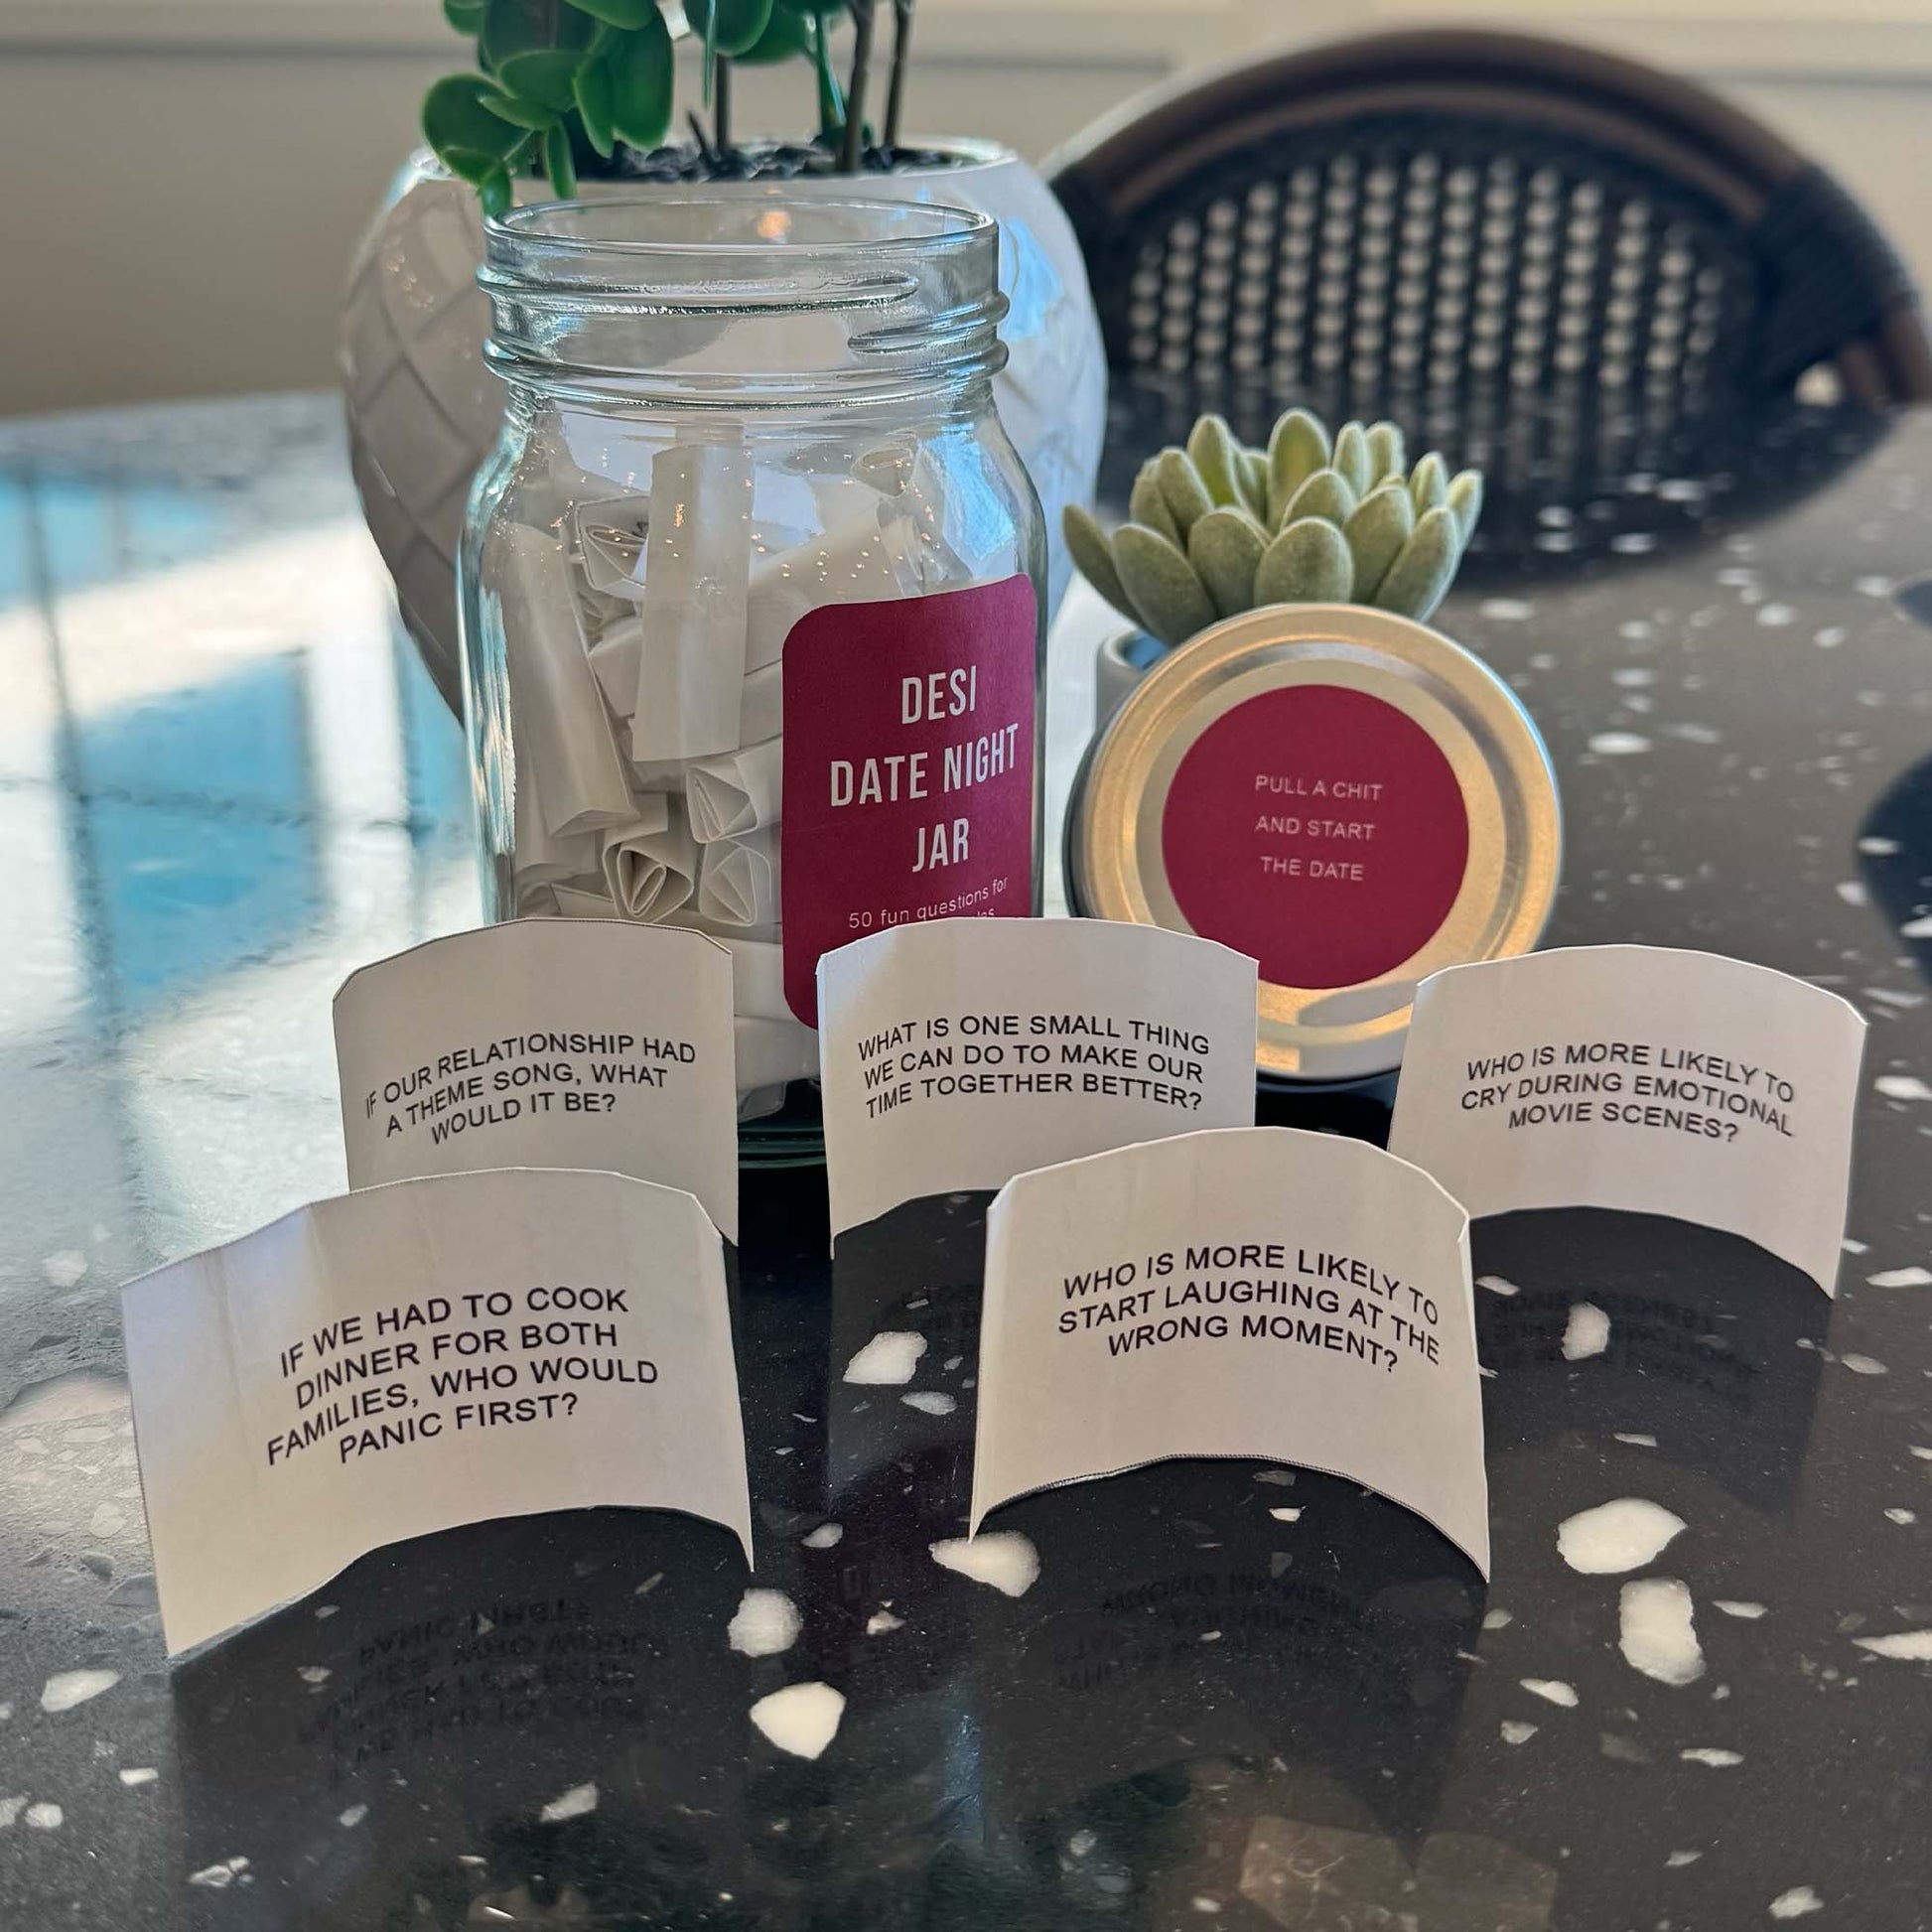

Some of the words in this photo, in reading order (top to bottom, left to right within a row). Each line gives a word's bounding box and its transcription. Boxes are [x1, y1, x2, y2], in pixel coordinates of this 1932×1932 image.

[901, 665, 977, 725] DESI
[830, 752, 928, 807] DATE
[943, 723, 1019, 793] NIGHT
[1255, 774, 1307, 795] PULL
[1311, 780, 1326, 796] A
[1332, 782, 1383, 801] CHIT
[911, 817, 969, 874] JAR
[1254, 815, 1300, 835] AND
[1307, 820, 1376, 840] START
[1260, 856, 1302, 876] THE
[1310, 861, 1363, 881] DATE
[849, 911, 873, 929] 50
[881, 909, 909, 925] fun
[916, 887, 989, 920] questions
[993, 878, 1009, 896] for
[858, 1022, 917, 1060] WHAT
[927, 1018, 949, 1038] IS
[960, 1016, 1020, 1035] ONE
[1030, 1016, 1120, 1037] SMALL
[1129, 1020, 1209, 1054] THING
[865, 1059, 894, 1089] WE
[900, 1045, 953, 1071] CAN
[964, 1044, 1004, 1064] DO
[1014, 1044, 1050, 1064] TO
[1061, 1044, 1138, 1068] MAKE
[1148, 1053, 1203, 1083] OUR
[365, 1091, 378, 1119] IF
[383, 1065, 432, 1104] OUR
[438, 1033, 634, 1079] RELATIONSHIP
[643, 1037, 695, 1063] HAD
[387, 1115, 402, 1138] A
[406, 1076, 484, 1127] THEME
[493, 1062, 581, 1091] SONG,
[592, 1063, 667, 1088] WHAT
[866, 1082, 912, 1119] TIME
[921, 1073, 1072, 1099] TOGETHER
[1083, 1075, 1201, 1111] BETTER?
[1467, 1052, 1524, 1081] WHO
[1533, 1045, 1555, 1067] IS
[1565, 1042, 1650, 1065] MORE
[1661, 1047, 1757, 1086] LIKELY
[1765, 1072, 1793, 1102] TO
[431, 1098, 521, 1145] WOULD
[531, 1092, 555, 1113] IT
[565, 1093, 616, 1112] BE?
[1461, 1083, 1513, 1110] CRY
[1518, 1072, 1621, 1099] DURING
[1634, 1075, 1793, 1138] EMOTIONAL
[1509, 1102, 1591, 1129] MOVIE
[1602, 1102, 1737, 1143] SCENES?
[1064, 1263, 1136, 1300] WHO
[1147, 1253, 1173, 1279] IS
[1185, 1245, 1285, 1271] MORE
[1298, 1249, 1400, 1301] LIKELY
[1409, 1287, 1438, 1325] TO
[281, 1342, 304, 1378] IF
[313, 1316, 362, 1355] WE
[376, 1298, 451, 1335] HAD
[463, 1292, 512, 1318] TO
[526, 1287, 627, 1312] COOK
[1058, 1290, 1156, 1333] START
[1165, 1280, 1339, 1313] LAUGHING
[1348, 1299, 1383, 1329] AT
[1391, 1315, 1440, 1364] THE
[1108, 1316, 1228, 1357] WRONG
[1241, 1315, 1398, 1372] MOMENT?
[297, 1342, 420, 1409] DINNER
[433, 1328, 508, 1360] FOR
[521, 1322, 618, 1349] BOTH
[267, 1381, 419, 1466] FAMILIES,
[431, 1364, 517, 1398] WHO
[530, 1356, 657, 1384] WOULD
[340, 1412, 443, 1463] PANIC
[457, 1392, 577, 1430] FIRST?
